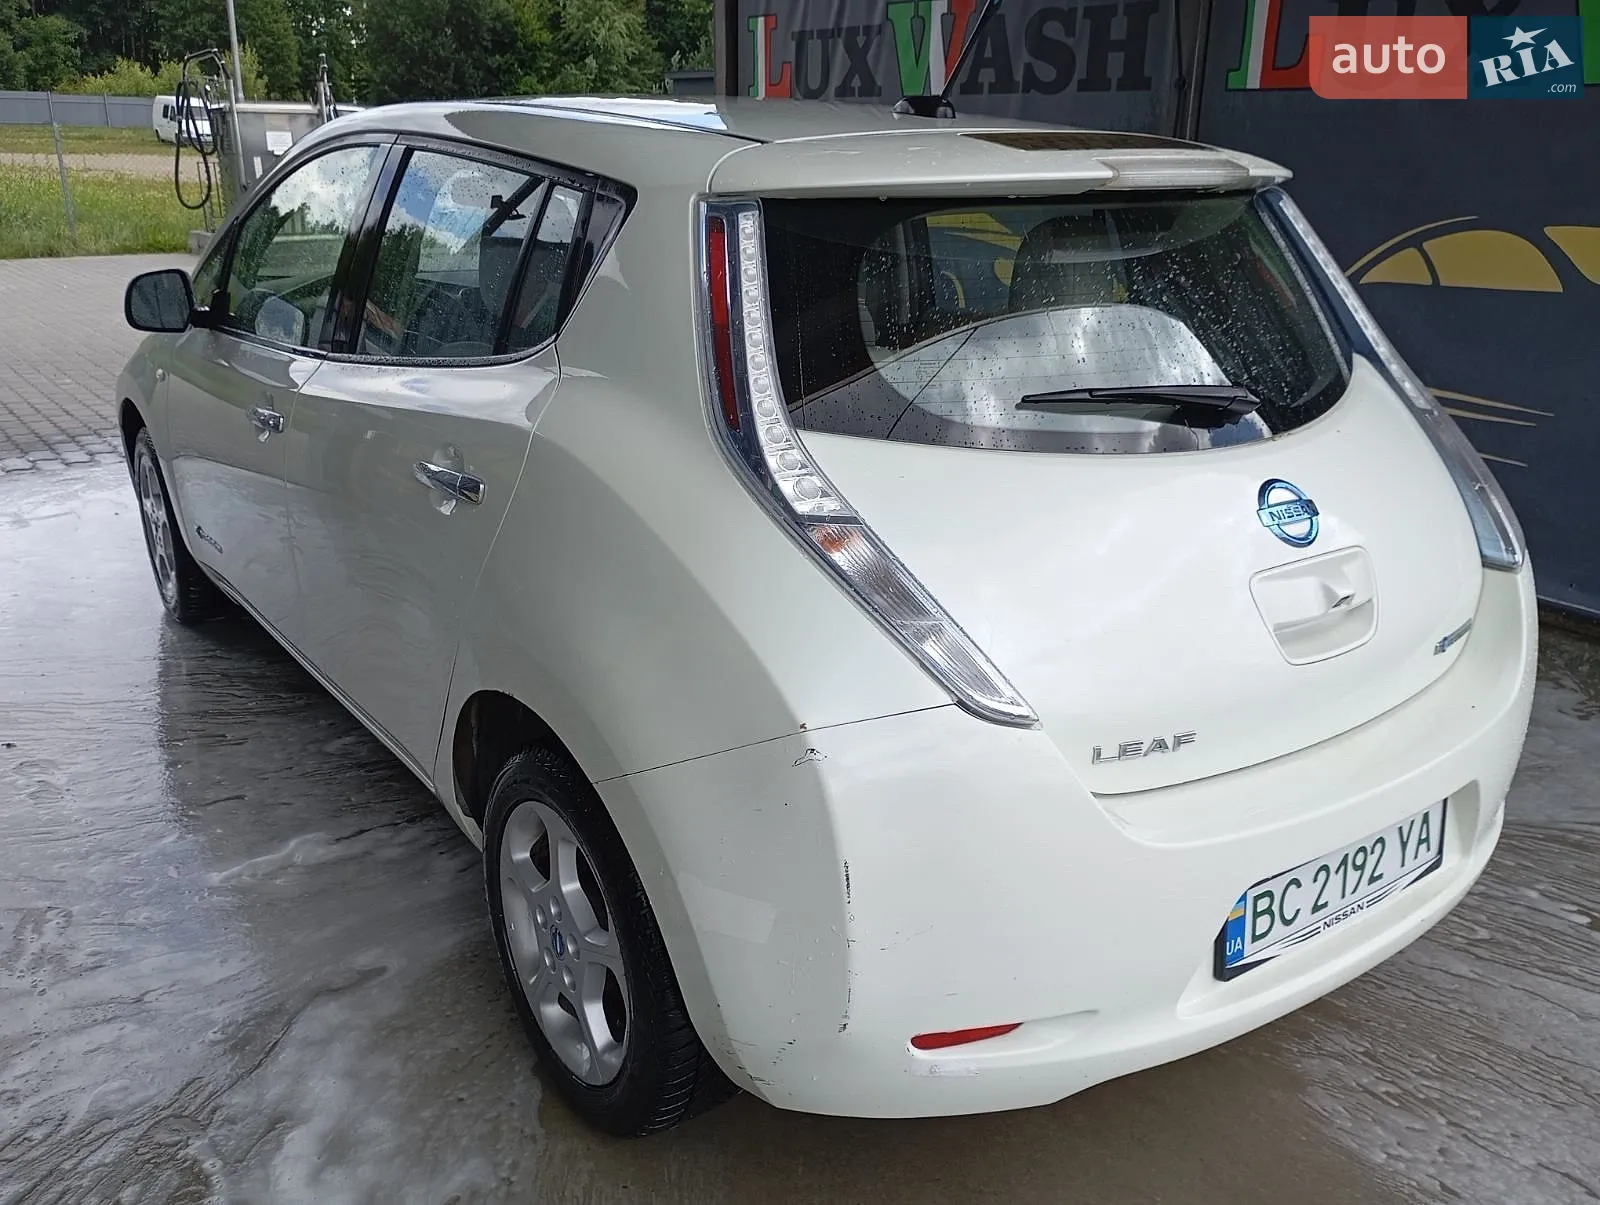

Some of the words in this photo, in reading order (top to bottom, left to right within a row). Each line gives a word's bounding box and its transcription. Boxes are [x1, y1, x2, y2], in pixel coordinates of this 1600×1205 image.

[1092, 730, 1197, 765] LEAF
[1250, 877, 1302, 944] BC
[1311, 836, 1386, 915] 2192
[1398, 810, 1431, 868] YA
[1322, 901, 1365, 931] NISSAN
[1226, 939, 1243, 956] UA
